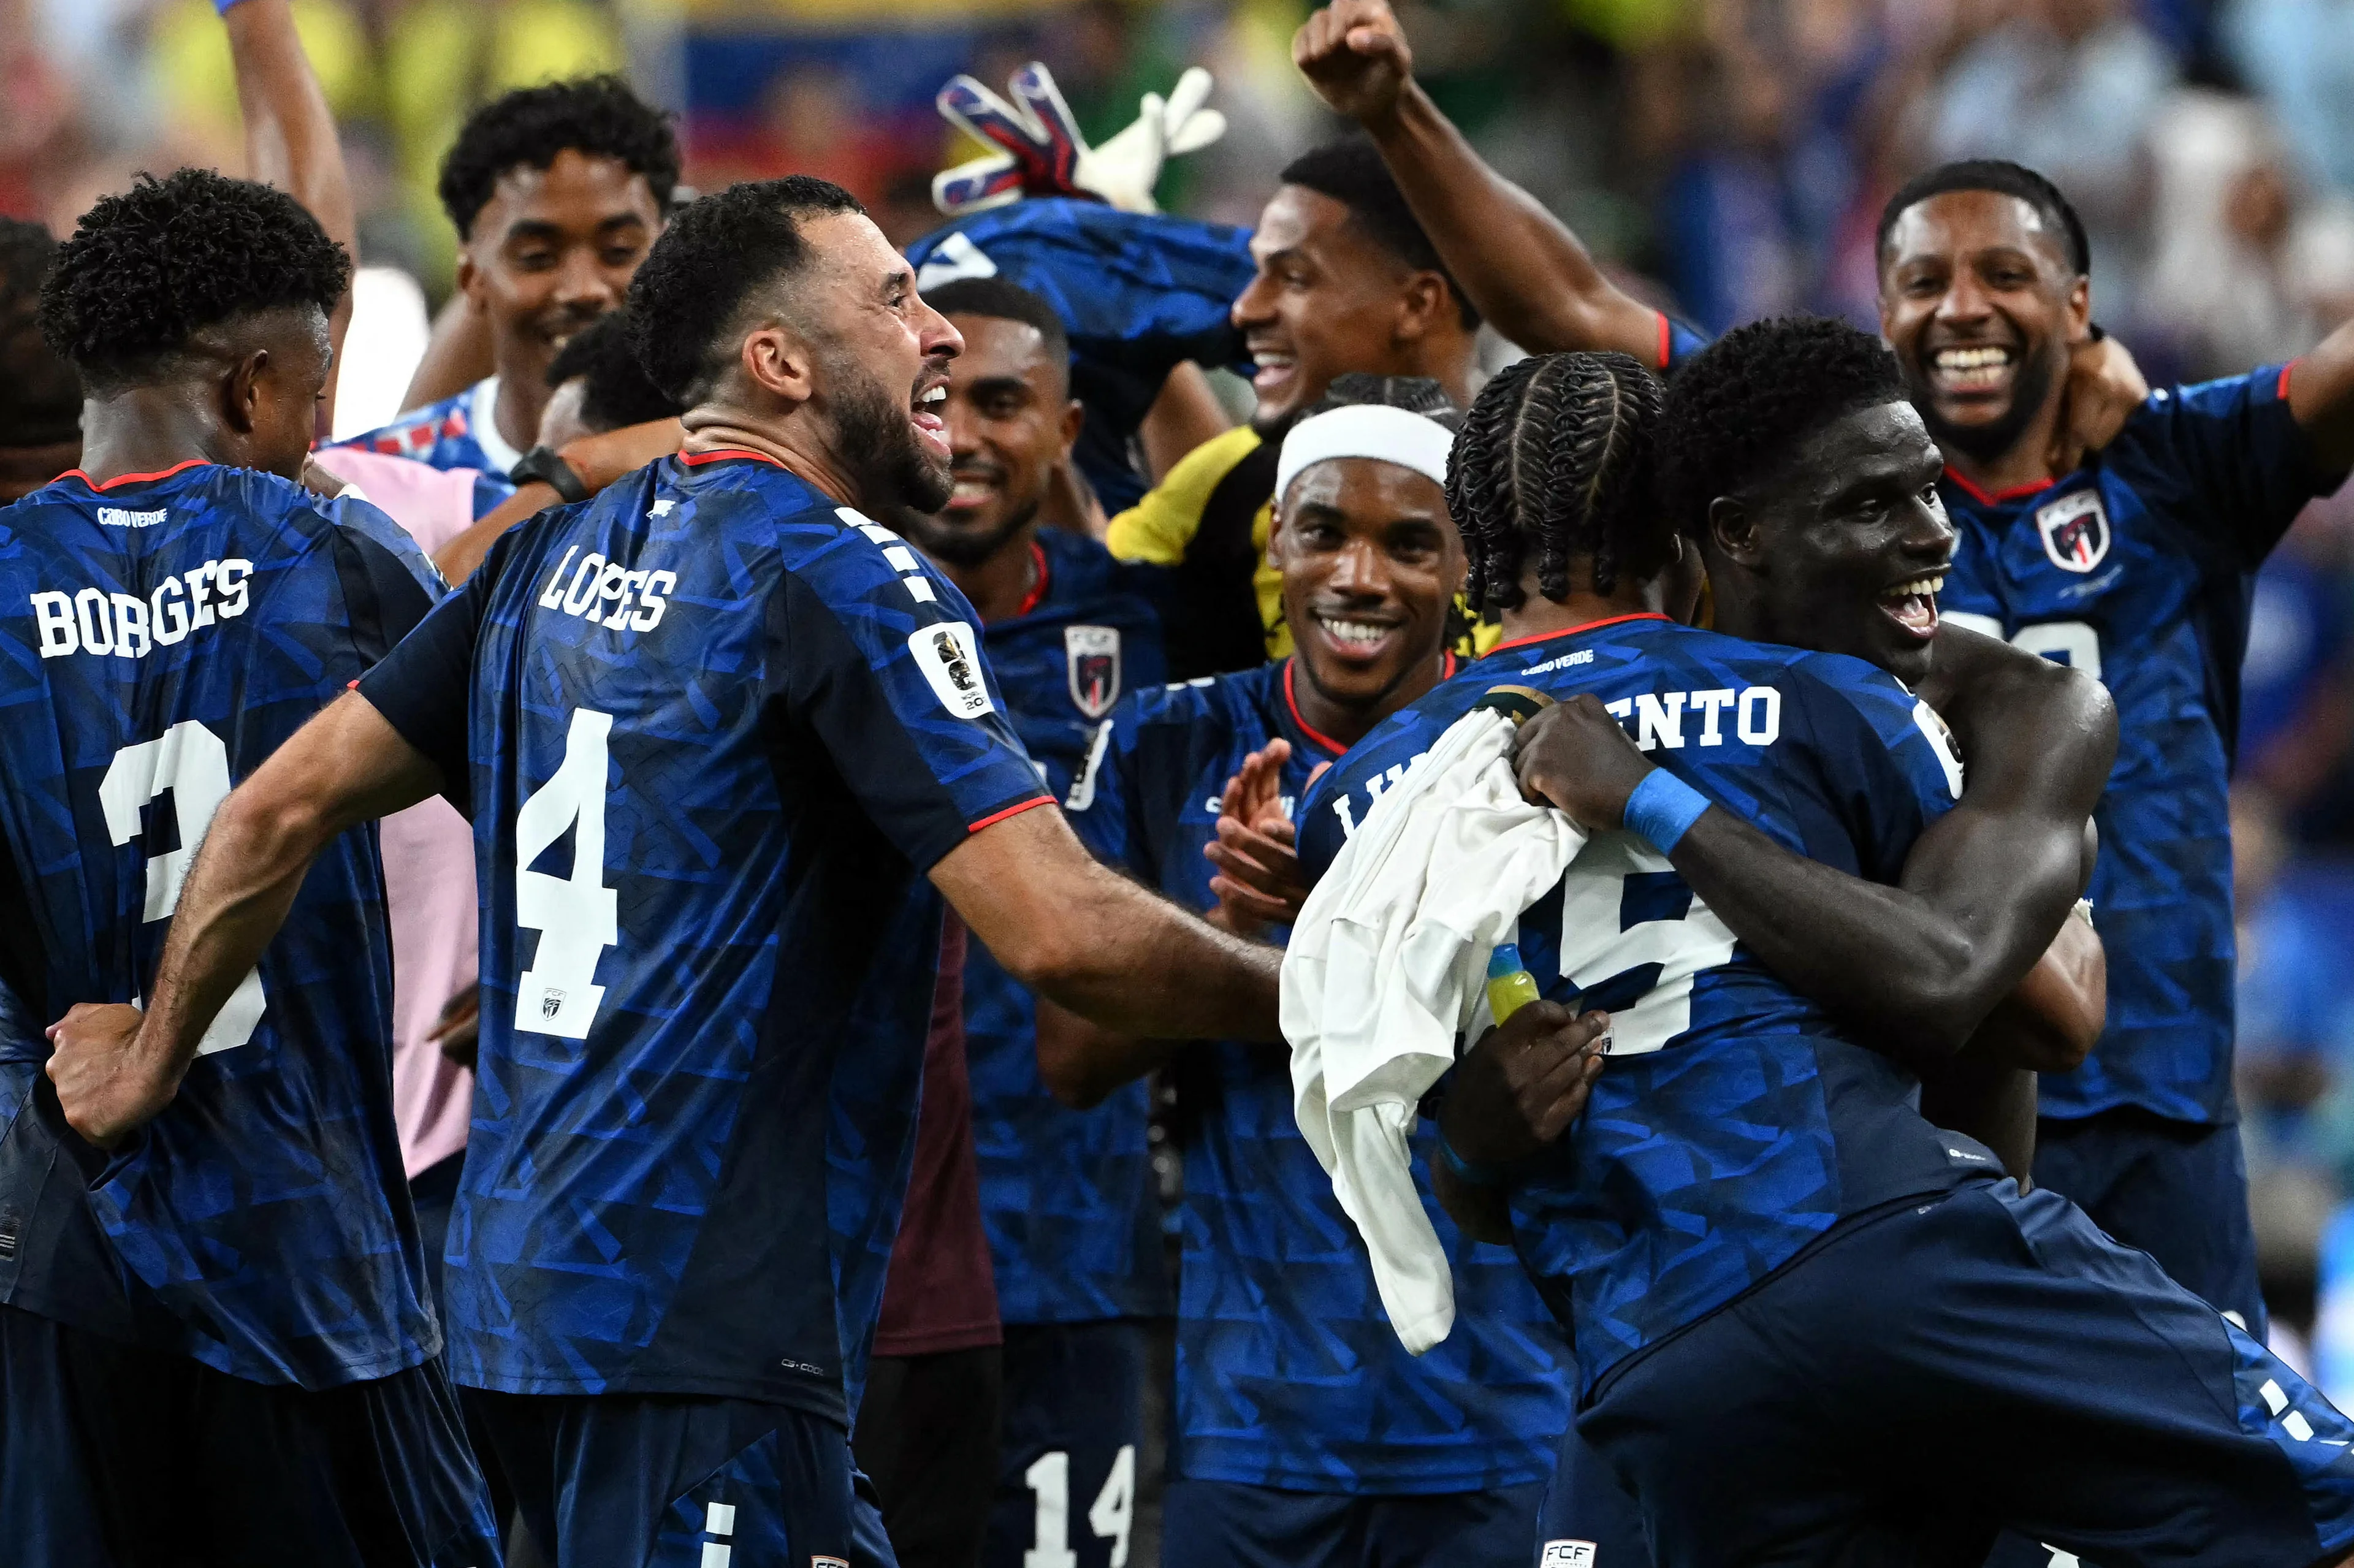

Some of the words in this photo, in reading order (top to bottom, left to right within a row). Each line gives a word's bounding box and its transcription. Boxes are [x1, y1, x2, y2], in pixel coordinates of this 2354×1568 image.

[130, 508, 167, 528] VERDE
[29, 558, 254, 658] BORGES
[538, 544, 677, 633] LOPES
[1555, 649, 1594, 669] VERDE
[514, 707, 618, 1040] 4
[1560, 829, 1738, 1056] 5
[1024, 1445, 1137, 1568] 14
[1546, 1545, 1590, 1561] FCF
